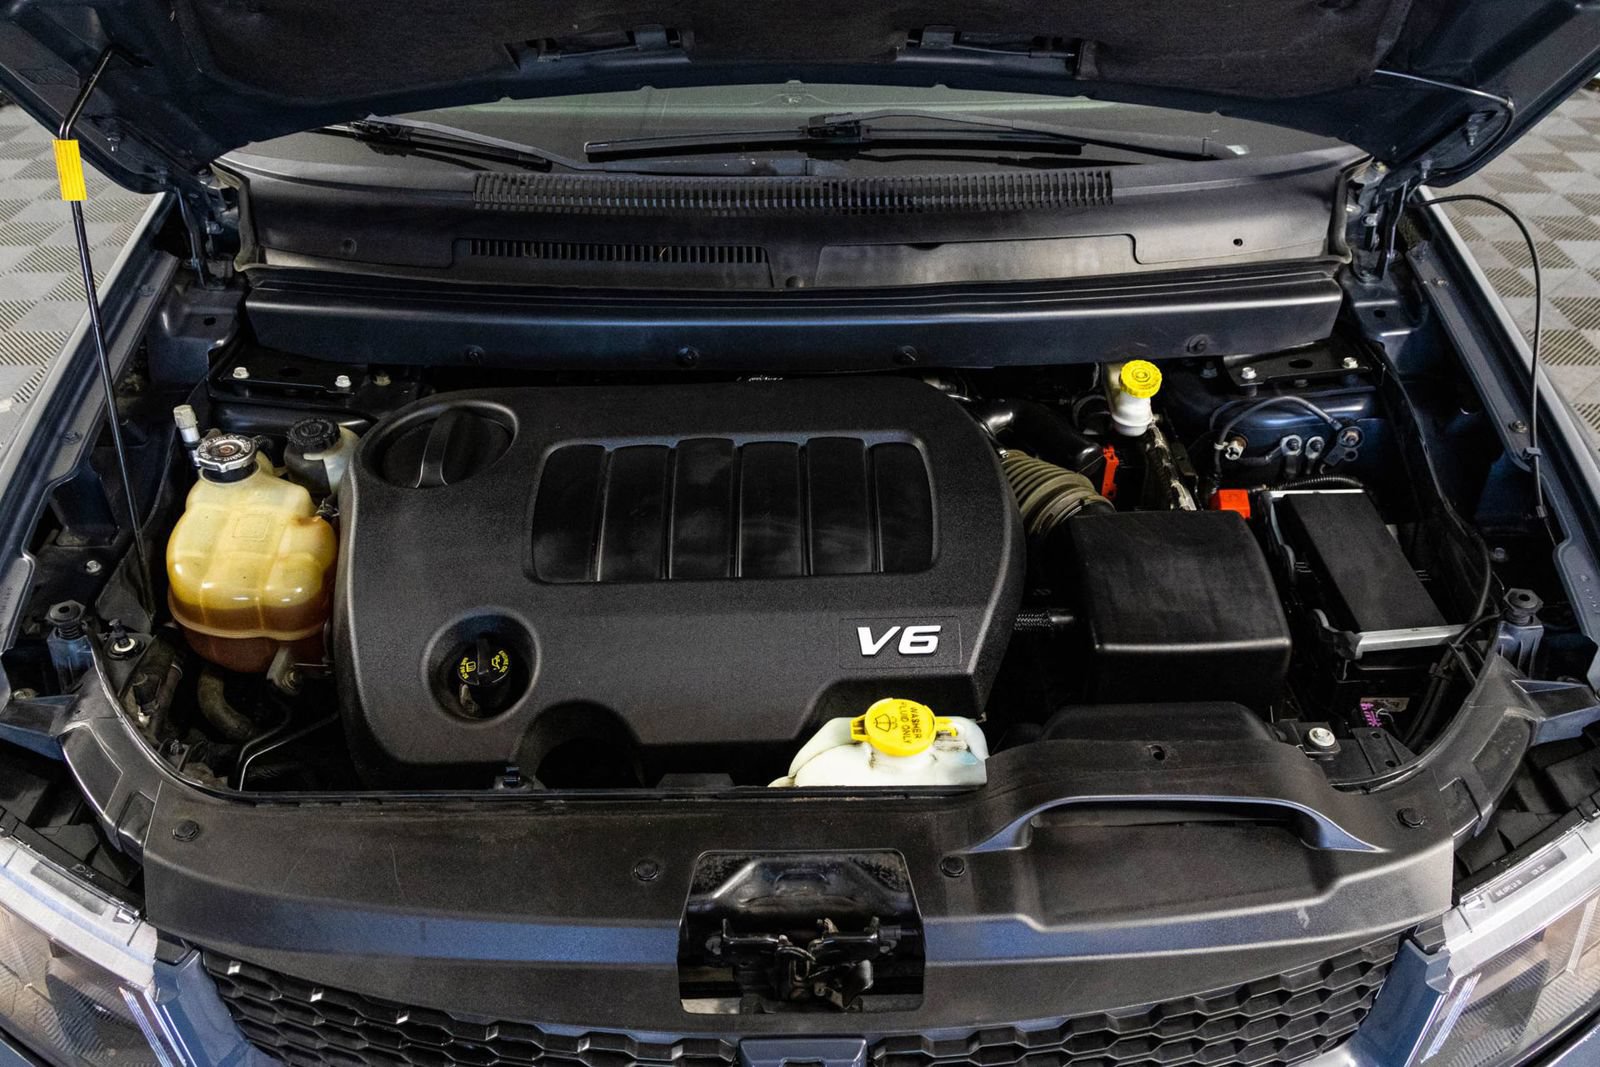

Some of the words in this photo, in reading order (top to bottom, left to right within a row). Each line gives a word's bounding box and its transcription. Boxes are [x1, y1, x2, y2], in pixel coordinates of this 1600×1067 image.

[857, 625, 941, 656] V6
[901, 725, 912, 744] ONLY
[910, 707, 922, 739] WASHER
